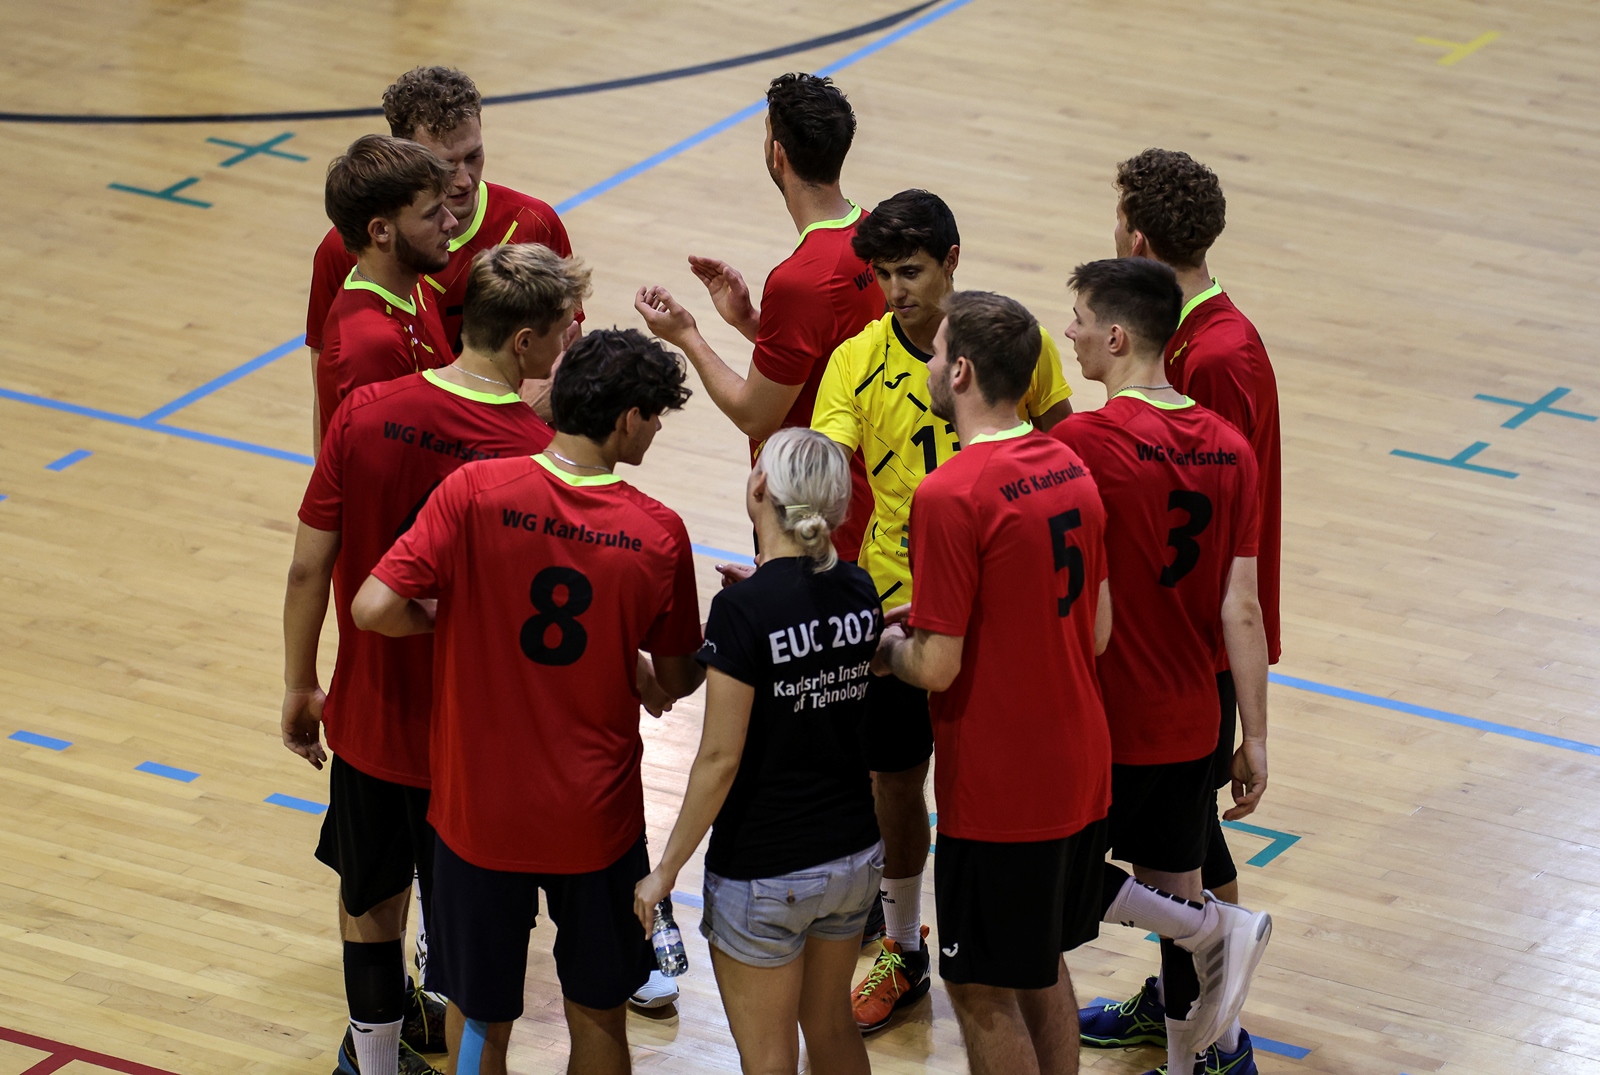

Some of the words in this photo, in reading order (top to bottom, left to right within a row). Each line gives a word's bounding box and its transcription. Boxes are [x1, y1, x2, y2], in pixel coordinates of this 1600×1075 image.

[853, 267, 874, 291] WG
[383, 421, 416, 444] WG
[1136, 444, 1165, 462] WG
[1165, 446, 1237, 466] Karlsruhe
[1000, 479, 1032, 501] WG
[1029, 462, 1087, 491] Karlsruhe
[502, 508, 537, 532] WG
[543, 516, 642, 552] Karlsruhe
[1158, 489, 1213, 588] 3
[1047, 507, 1085, 618] 5
[520, 566, 593, 666] 8
[768, 620, 824, 664] EUC
[793, 693, 806, 713] of
